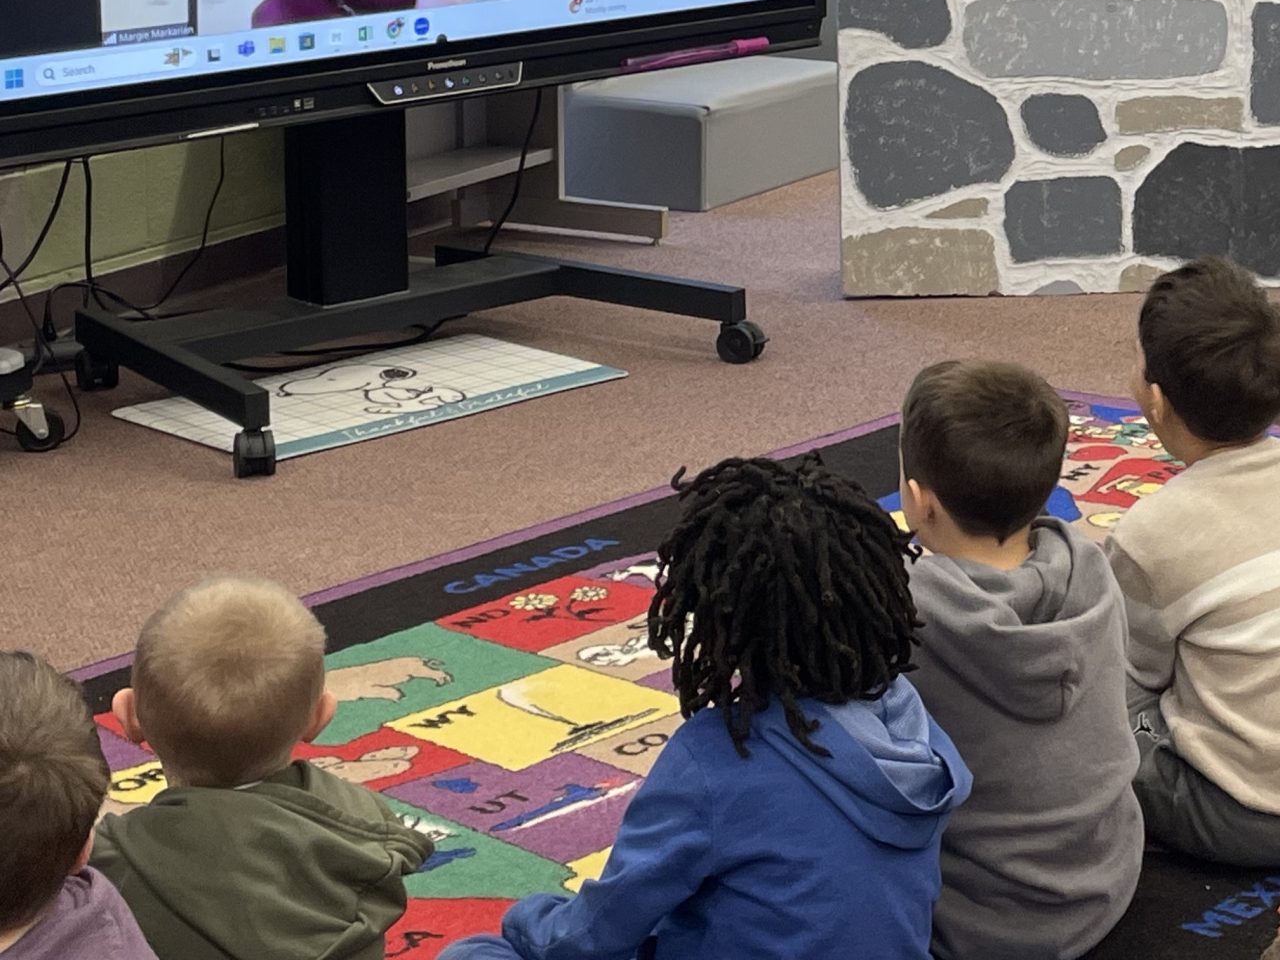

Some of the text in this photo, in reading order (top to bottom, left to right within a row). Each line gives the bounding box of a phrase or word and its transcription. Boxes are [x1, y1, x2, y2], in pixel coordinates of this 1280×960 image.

[118, 30, 149, 43] Margie
[62, 64, 96, 78] Search
[342, 410, 444, 440] Thankful
[444, 537, 620, 594] CANADA
[451, 608, 511, 630] ND
[407, 704, 477, 729] WY
[613, 732, 669, 756] CO
[112, 768, 164, 791] OR
[468, 789, 530, 815] UT
